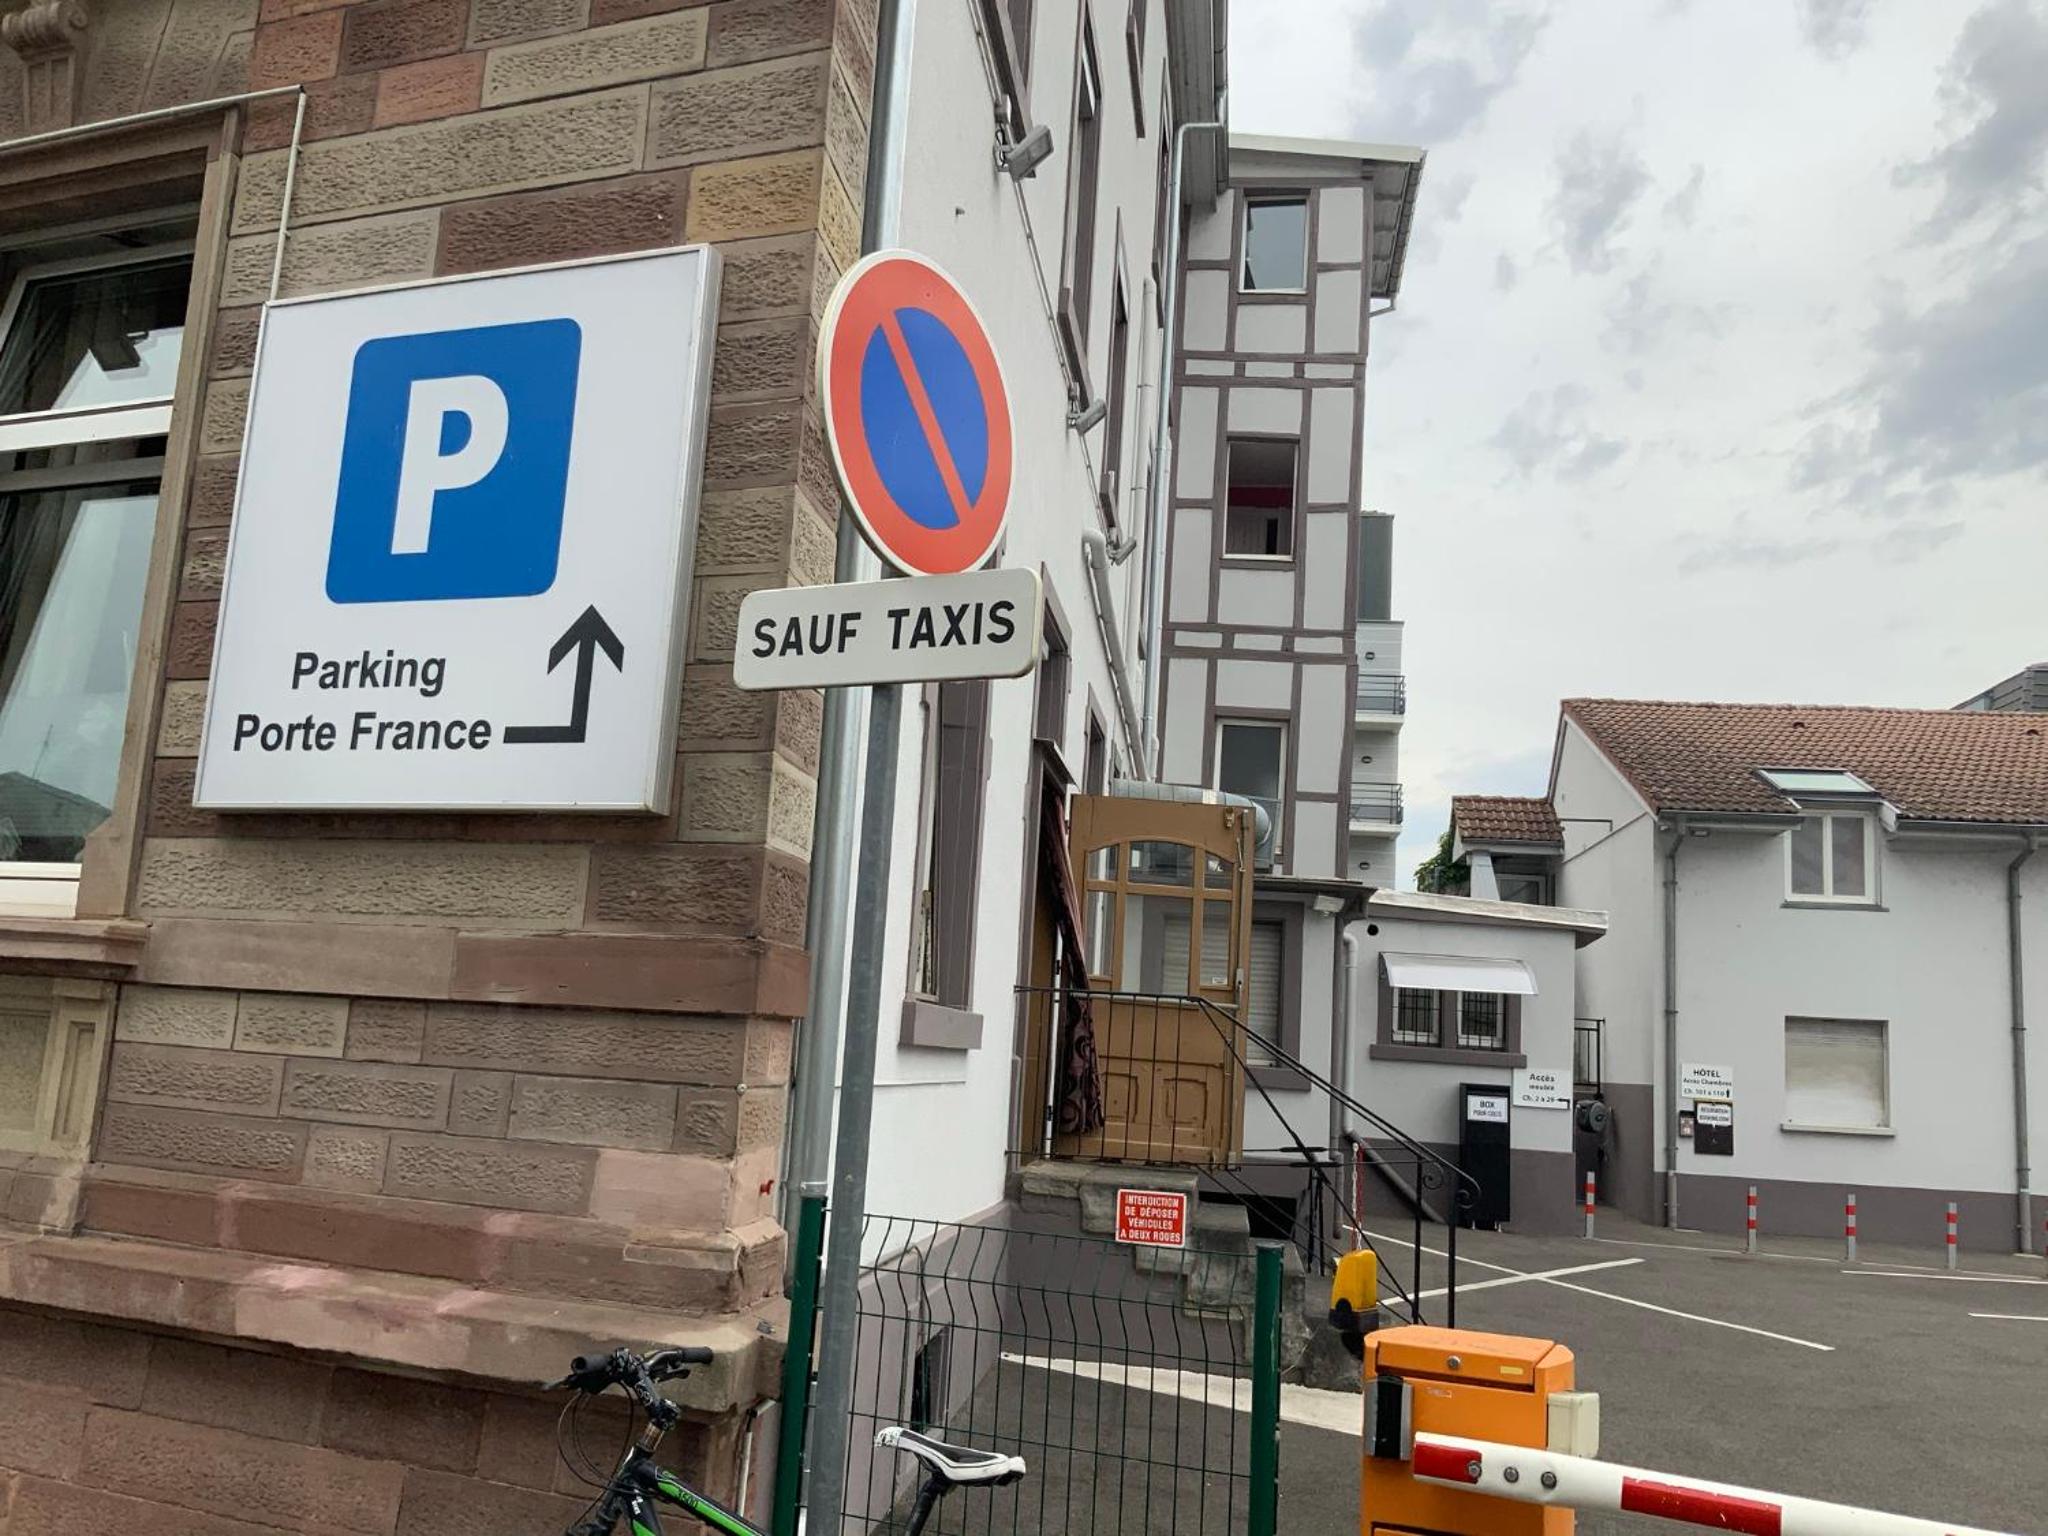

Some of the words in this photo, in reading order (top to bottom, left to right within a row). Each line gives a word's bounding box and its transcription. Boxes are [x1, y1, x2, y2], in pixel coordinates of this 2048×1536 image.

[391, 374, 509, 554] P
[752, 612, 861, 658] SAUF
[888, 600, 1015, 644] TAXIS
[291, 649, 446, 697] Parking
[233, 714, 336, 752] Porte
[350, 711, 492, 751] France
[1529, 1072, 1555, 1082] Accès
[1693, 1068, 1720, 1078] HÔTEL
[1480, 1100, 1495, 1108] BOX
[1125, 1194, 1179, 1207] INTERDICTION
[1124, 1206, 1136, 1216] DE
[1129, 1229, 1152, 1240] DEUX
[1153, 1231, 1181, 1242] ROUES
